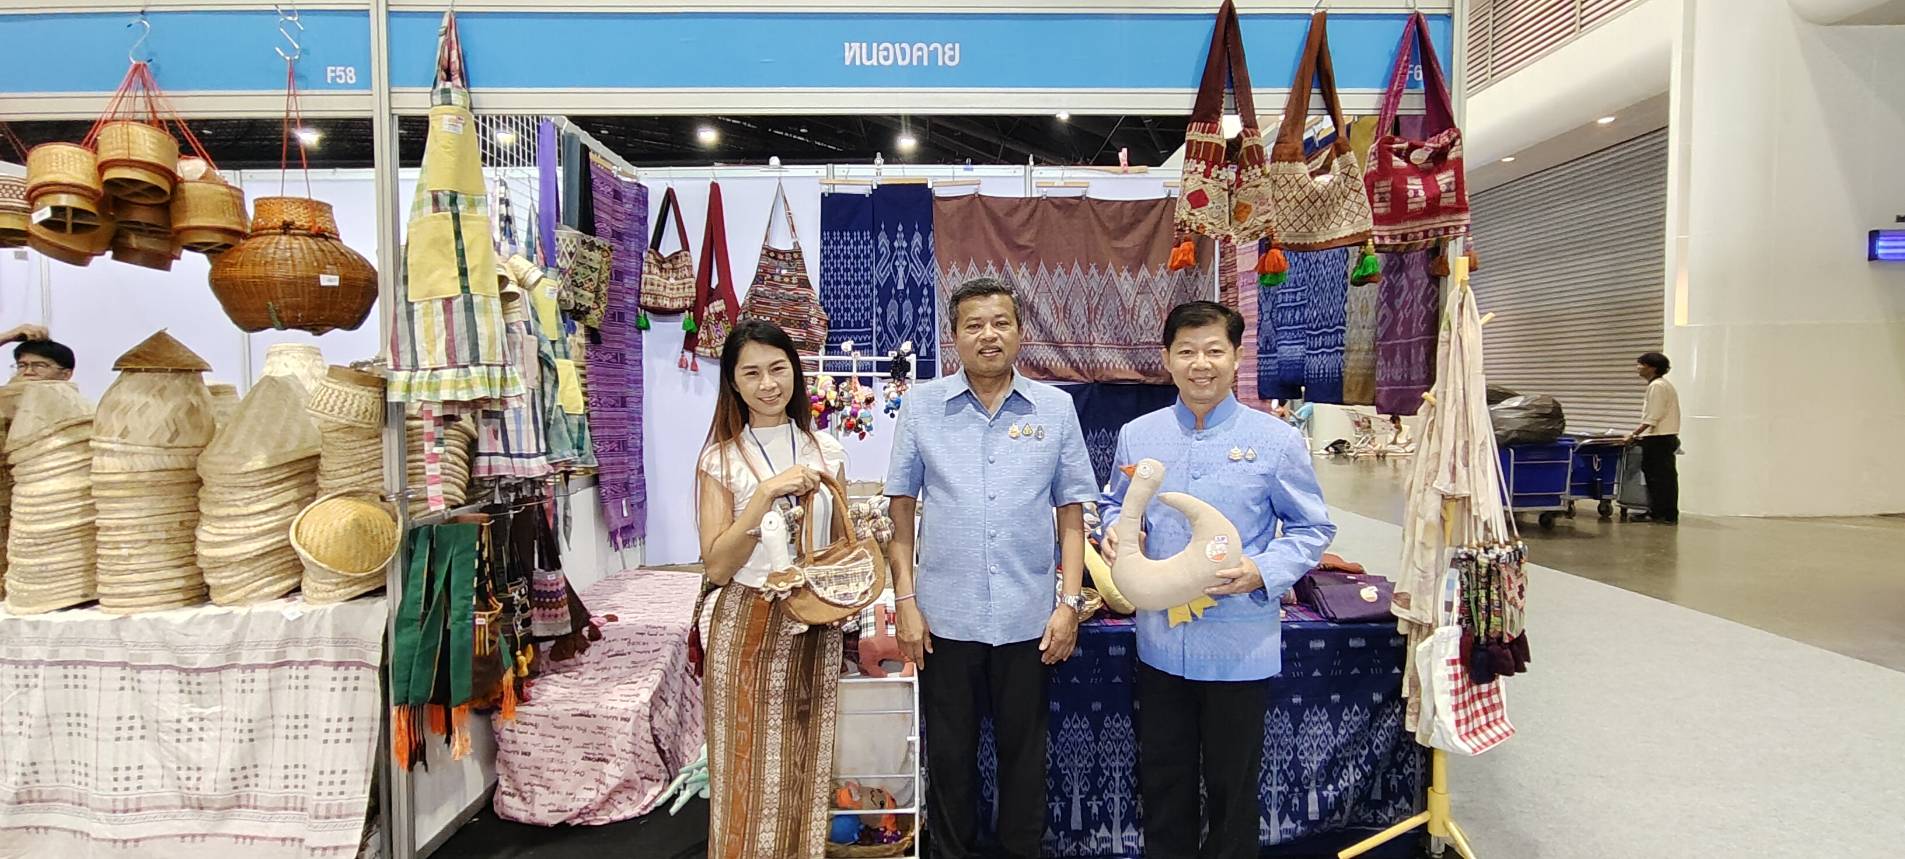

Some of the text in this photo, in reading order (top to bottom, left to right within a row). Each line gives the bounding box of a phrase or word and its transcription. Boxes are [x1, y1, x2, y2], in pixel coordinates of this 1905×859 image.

[843, 41, 961, 67] หนองคาย
[326, 66, 357, 84] F58
[1408, 64, 1423, 82] F6
